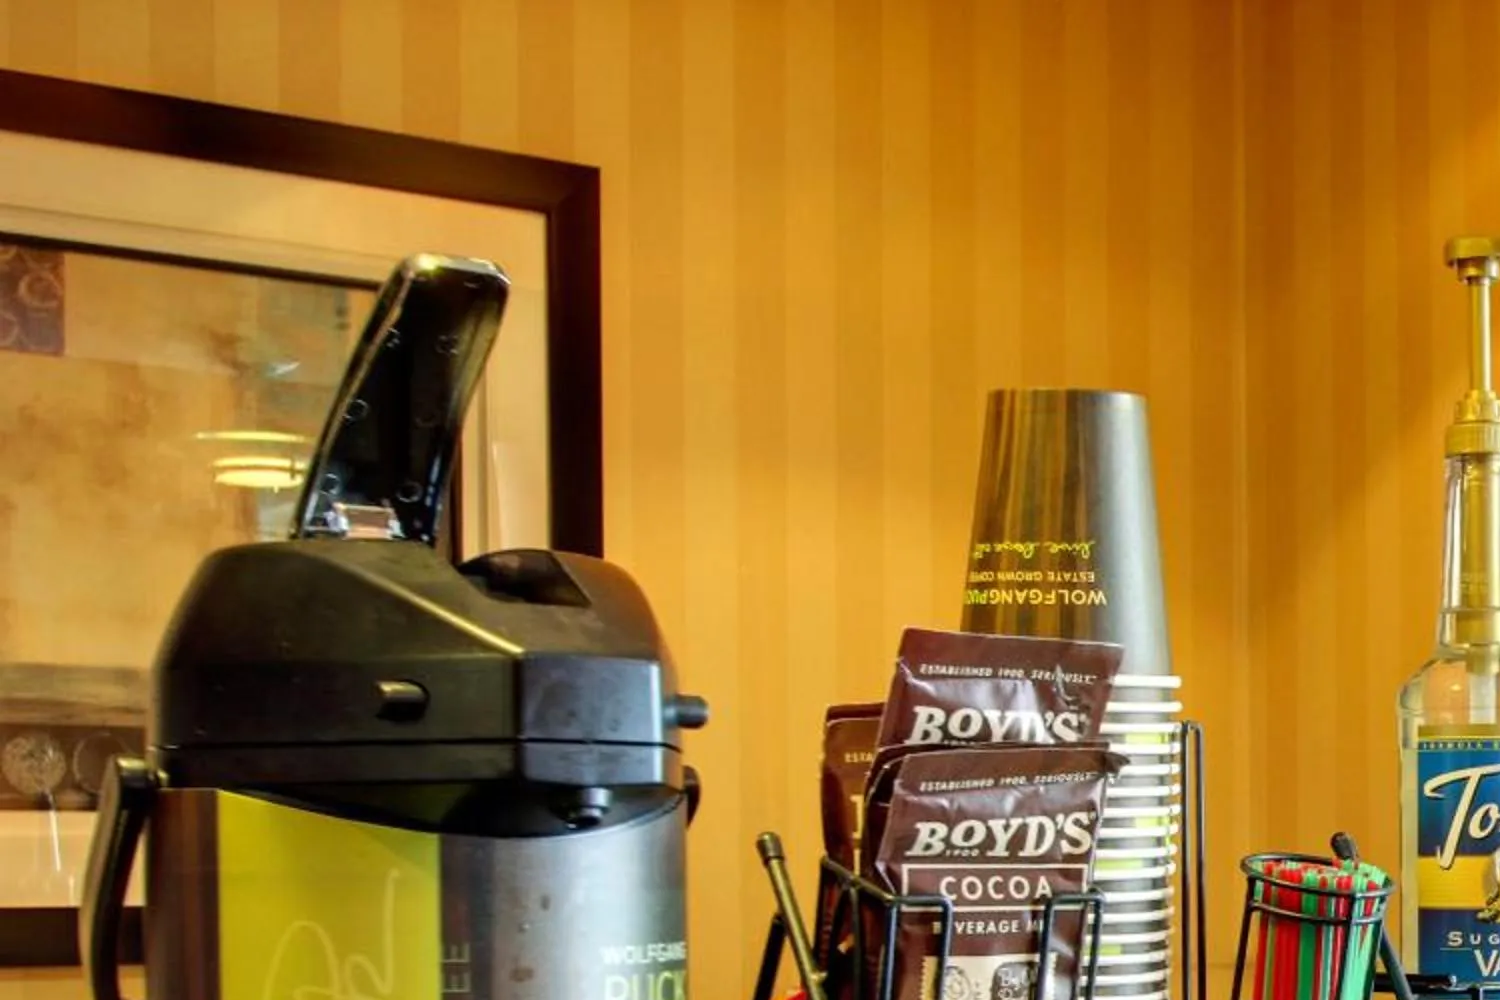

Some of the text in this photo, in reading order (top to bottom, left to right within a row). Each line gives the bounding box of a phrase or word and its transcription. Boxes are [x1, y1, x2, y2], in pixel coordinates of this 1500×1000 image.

[904, 812, 1093, 857] BOYD'S
[939, 875, 1053, 901] COCOA
[932, 920, 1020, 936] BVERAGE
